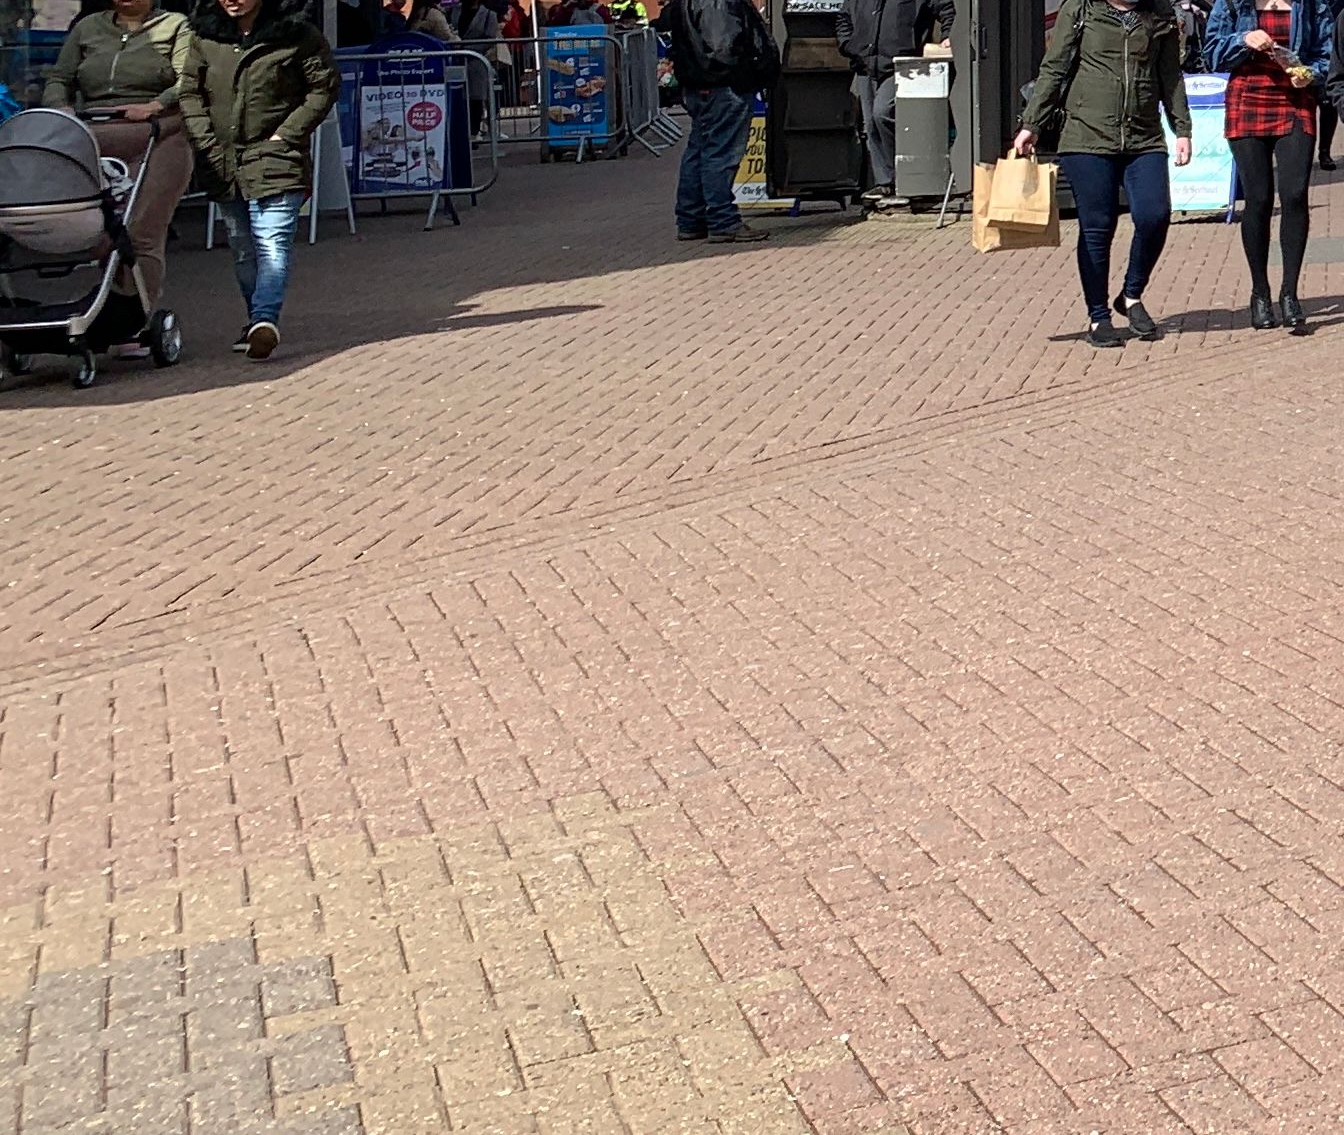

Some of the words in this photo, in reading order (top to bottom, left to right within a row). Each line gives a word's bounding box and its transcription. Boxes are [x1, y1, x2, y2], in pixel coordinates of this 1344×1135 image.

[801, 2, 826, 11] SALE
[366, 90, 403, 102] VIDEO
[420, 89, 445, 98] DVD
